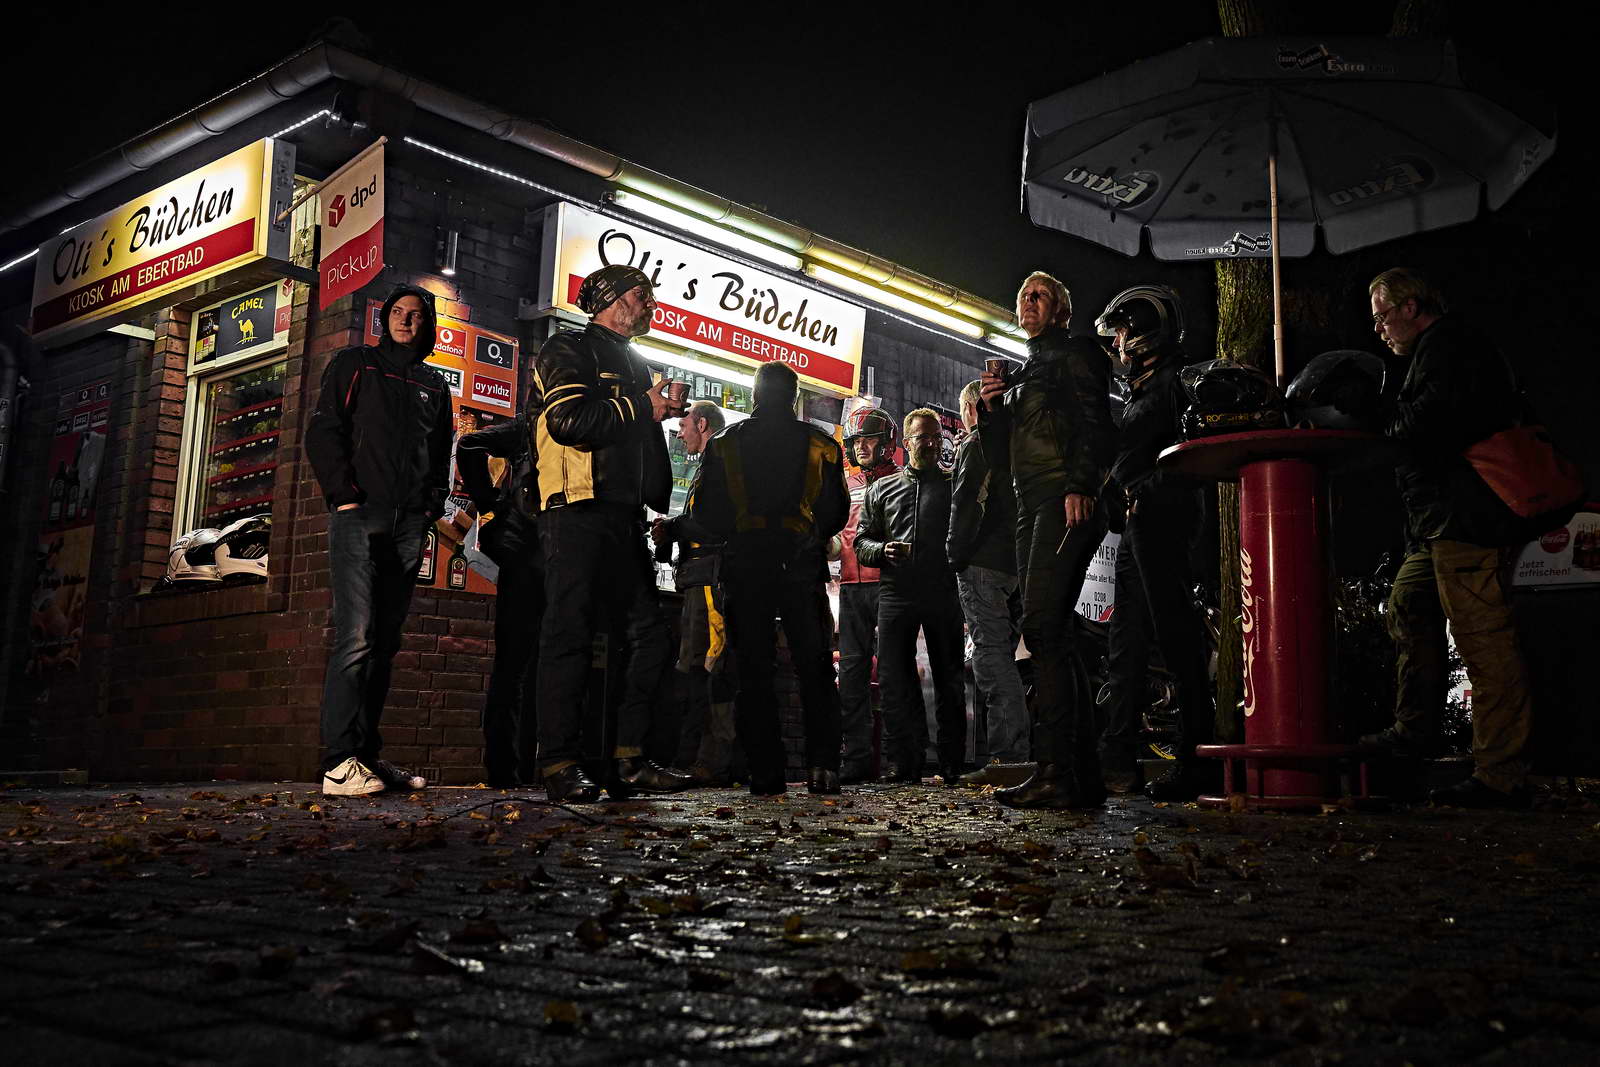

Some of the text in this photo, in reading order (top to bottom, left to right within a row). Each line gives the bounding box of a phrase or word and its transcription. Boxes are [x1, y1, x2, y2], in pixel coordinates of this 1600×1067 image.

[350, 173, 377, 209] dpd
[125, 179, 235, 254] Büdchen
[68, 245, 205, 314] KIOSK AM EBERTBAD
[231, 297, 265, 320] CAMEL
[711, 271, 838, 347] Büdchen
[696, 321, 723, 343] AM
[732, 330, 809, 369] EBERTBAD
[1519, 559, 1545, 569] Jetzt
